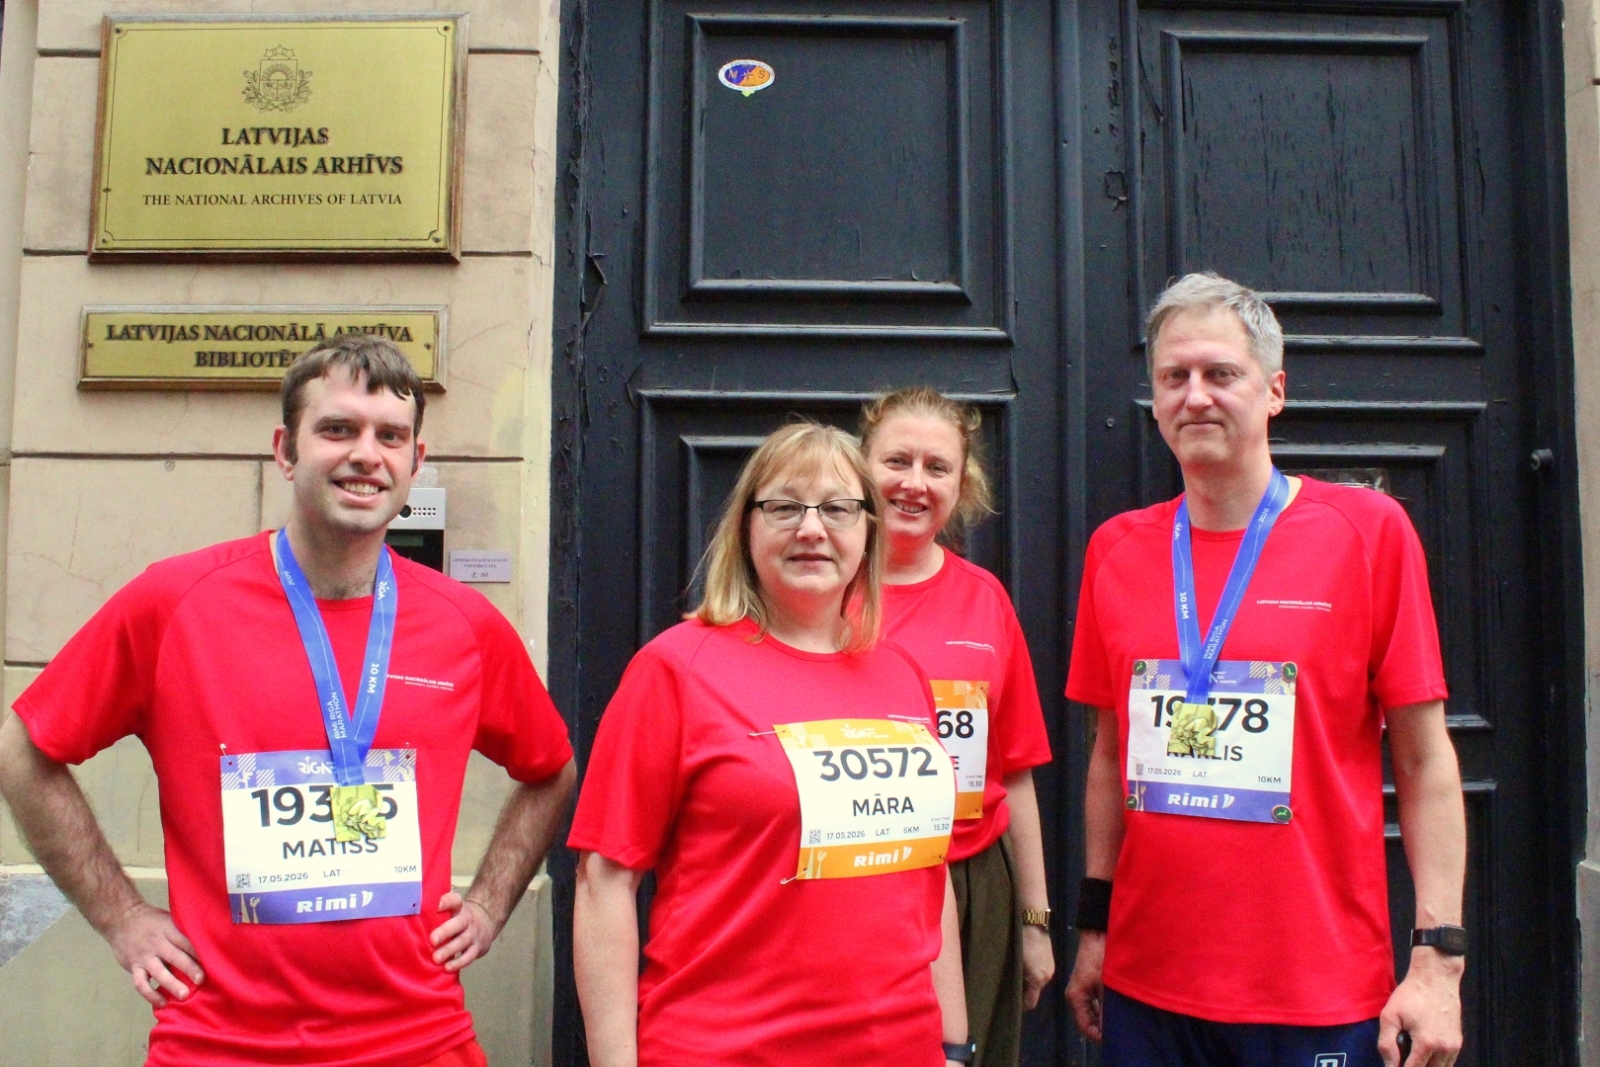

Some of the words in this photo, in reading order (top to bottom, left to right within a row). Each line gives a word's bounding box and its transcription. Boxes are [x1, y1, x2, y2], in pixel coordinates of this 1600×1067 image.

[221, 127, 329, 148] LATVIJAS
[145, 154, 307, 175] NACIONĀLAIS
[312, 153, 403, 175] ARHĪVS
[143, 195, 171, 206] THE
[175, 195, 247, 206] NATIONAL
[251, 194, 323, 205] ARCHIVES
[327, 194, 346, 205] OF
[351, 194, 402, 205] LATVIA
[106, 324, 199, 343] LATVIJAS
[203, 322, 324, 342] NACIONĀLĀ
[1179, 591, 1188, 603] 10
[1180, 603, 1189, 620] KM
[370, 662, 380, 675] 10
[367, 676, 378, 694] KM
[326, 700, 337, 720] RIGA
[330, 691, 348, 738] MARATHON
[331, 721, 342, 739] RIMI
[813, 746, 938, 782] 30572
[1147, 767, 1182, 777] 17.05.2026
[1192, 770, 1208, 778] LAT
[1257, 775, 1282, 785] 10KM
[251, 783, 399, 828] 1935
[852, 793, 915, 817] MĀRA
[1167, 792, 1219, 809] Rimi
[826, 830, 866, 841] 17.05.2026
[875, 828, 890, 837] LAT
[903, 825, 920, 835] 6KM
[853, 849, 899, 868] Rimi
[258, 872, 309, 884] 17.05.2026
[323, 869, 341, 878] LAT
[394, 865, 417, 874] 10KM
[296, 891, 357, 914] Rimi
